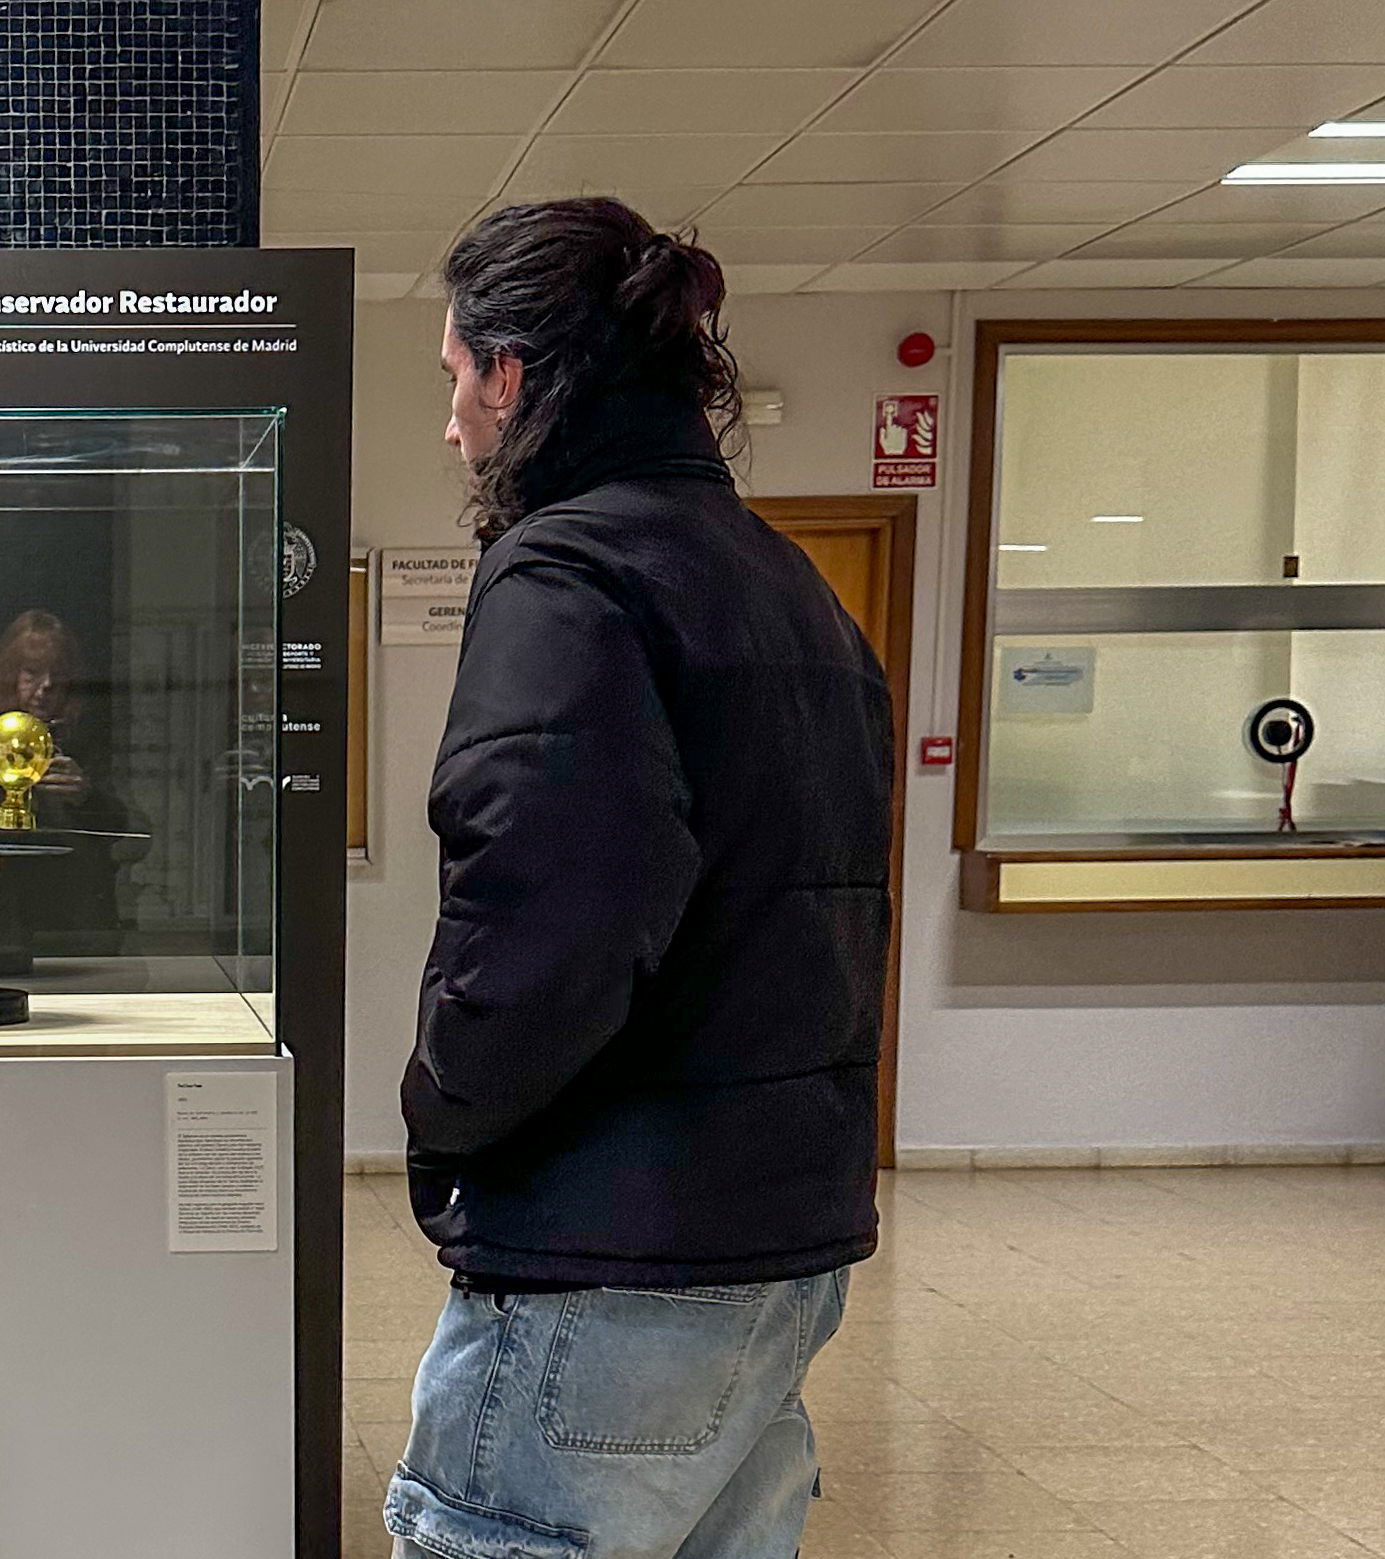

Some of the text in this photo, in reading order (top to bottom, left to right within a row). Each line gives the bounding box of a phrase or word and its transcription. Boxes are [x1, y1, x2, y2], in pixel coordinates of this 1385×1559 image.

[119, 289, 278, 314] Restaurador
[38, 339, 55, 353] de
[56, 339, 69, 353] la
[70, 339, 146, 353] Universidad
[147, 339, 231, 355] Complutense
[233, 339, 249, 352] de
[251, 338, 297, 352] Madrid
[878, 465, 931, 474] PULSADOR
[891, 476, 932, 485] ALARMA
[392, 560, 449, 570] FACULTAD
[451, 559, 466, 570] DE
[454, 574, 468, 584] de
